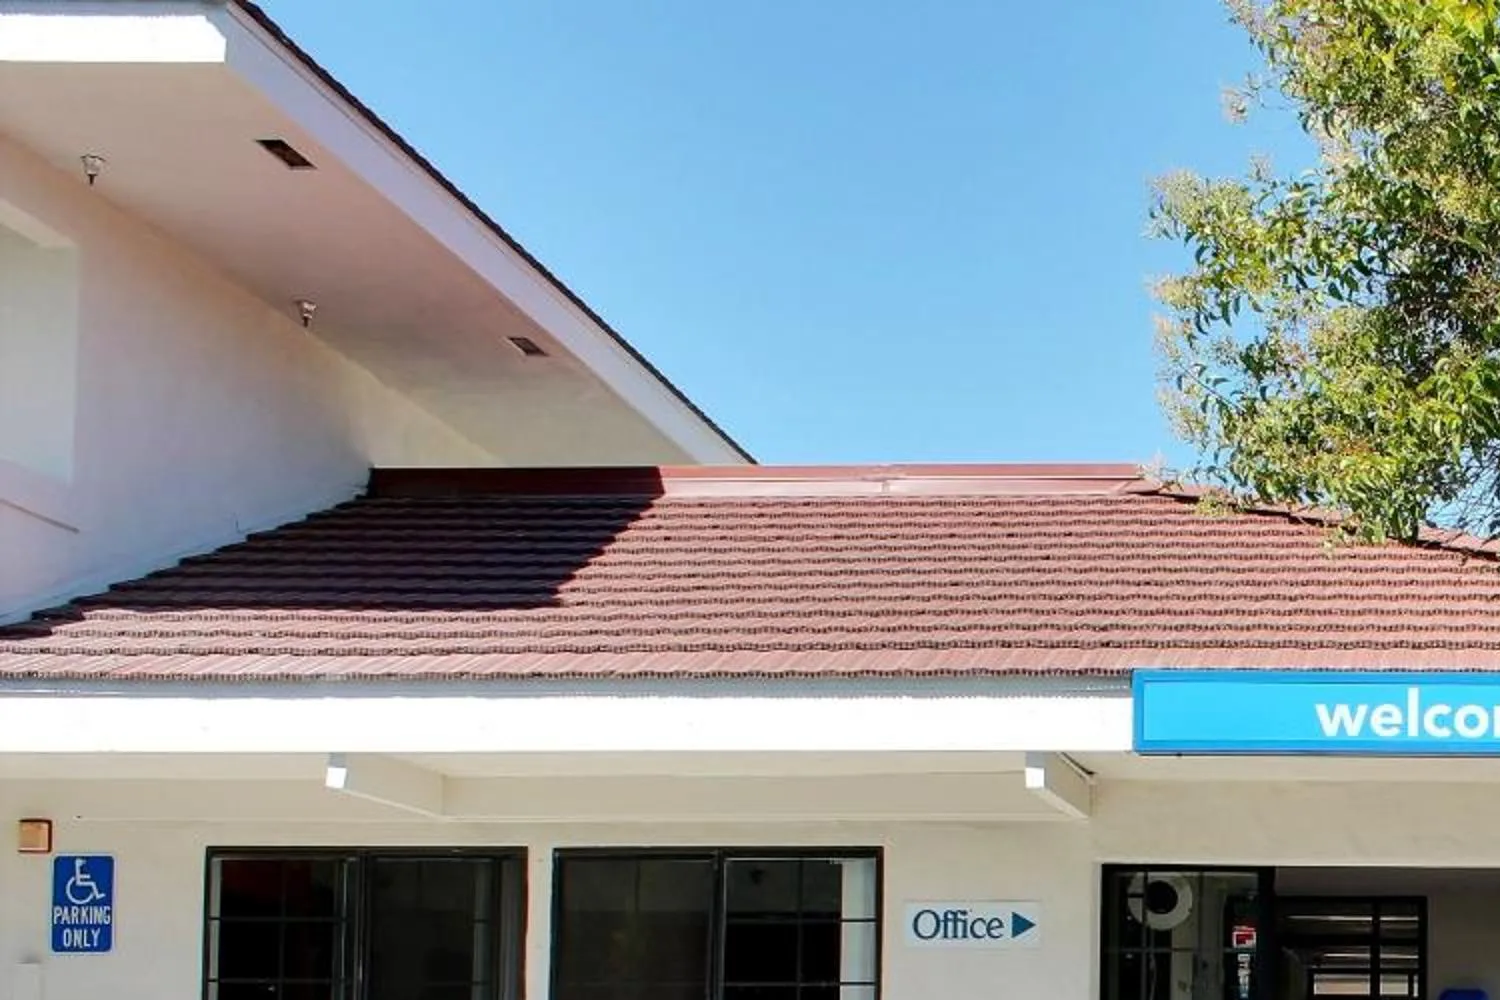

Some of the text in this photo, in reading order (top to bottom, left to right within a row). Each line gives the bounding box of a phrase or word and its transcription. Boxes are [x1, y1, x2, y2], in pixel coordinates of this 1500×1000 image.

[53, 905, 111, 925] PARKING
[912, 908, 1005, 940] Office
[63, 928, 101, 948] ONLY
